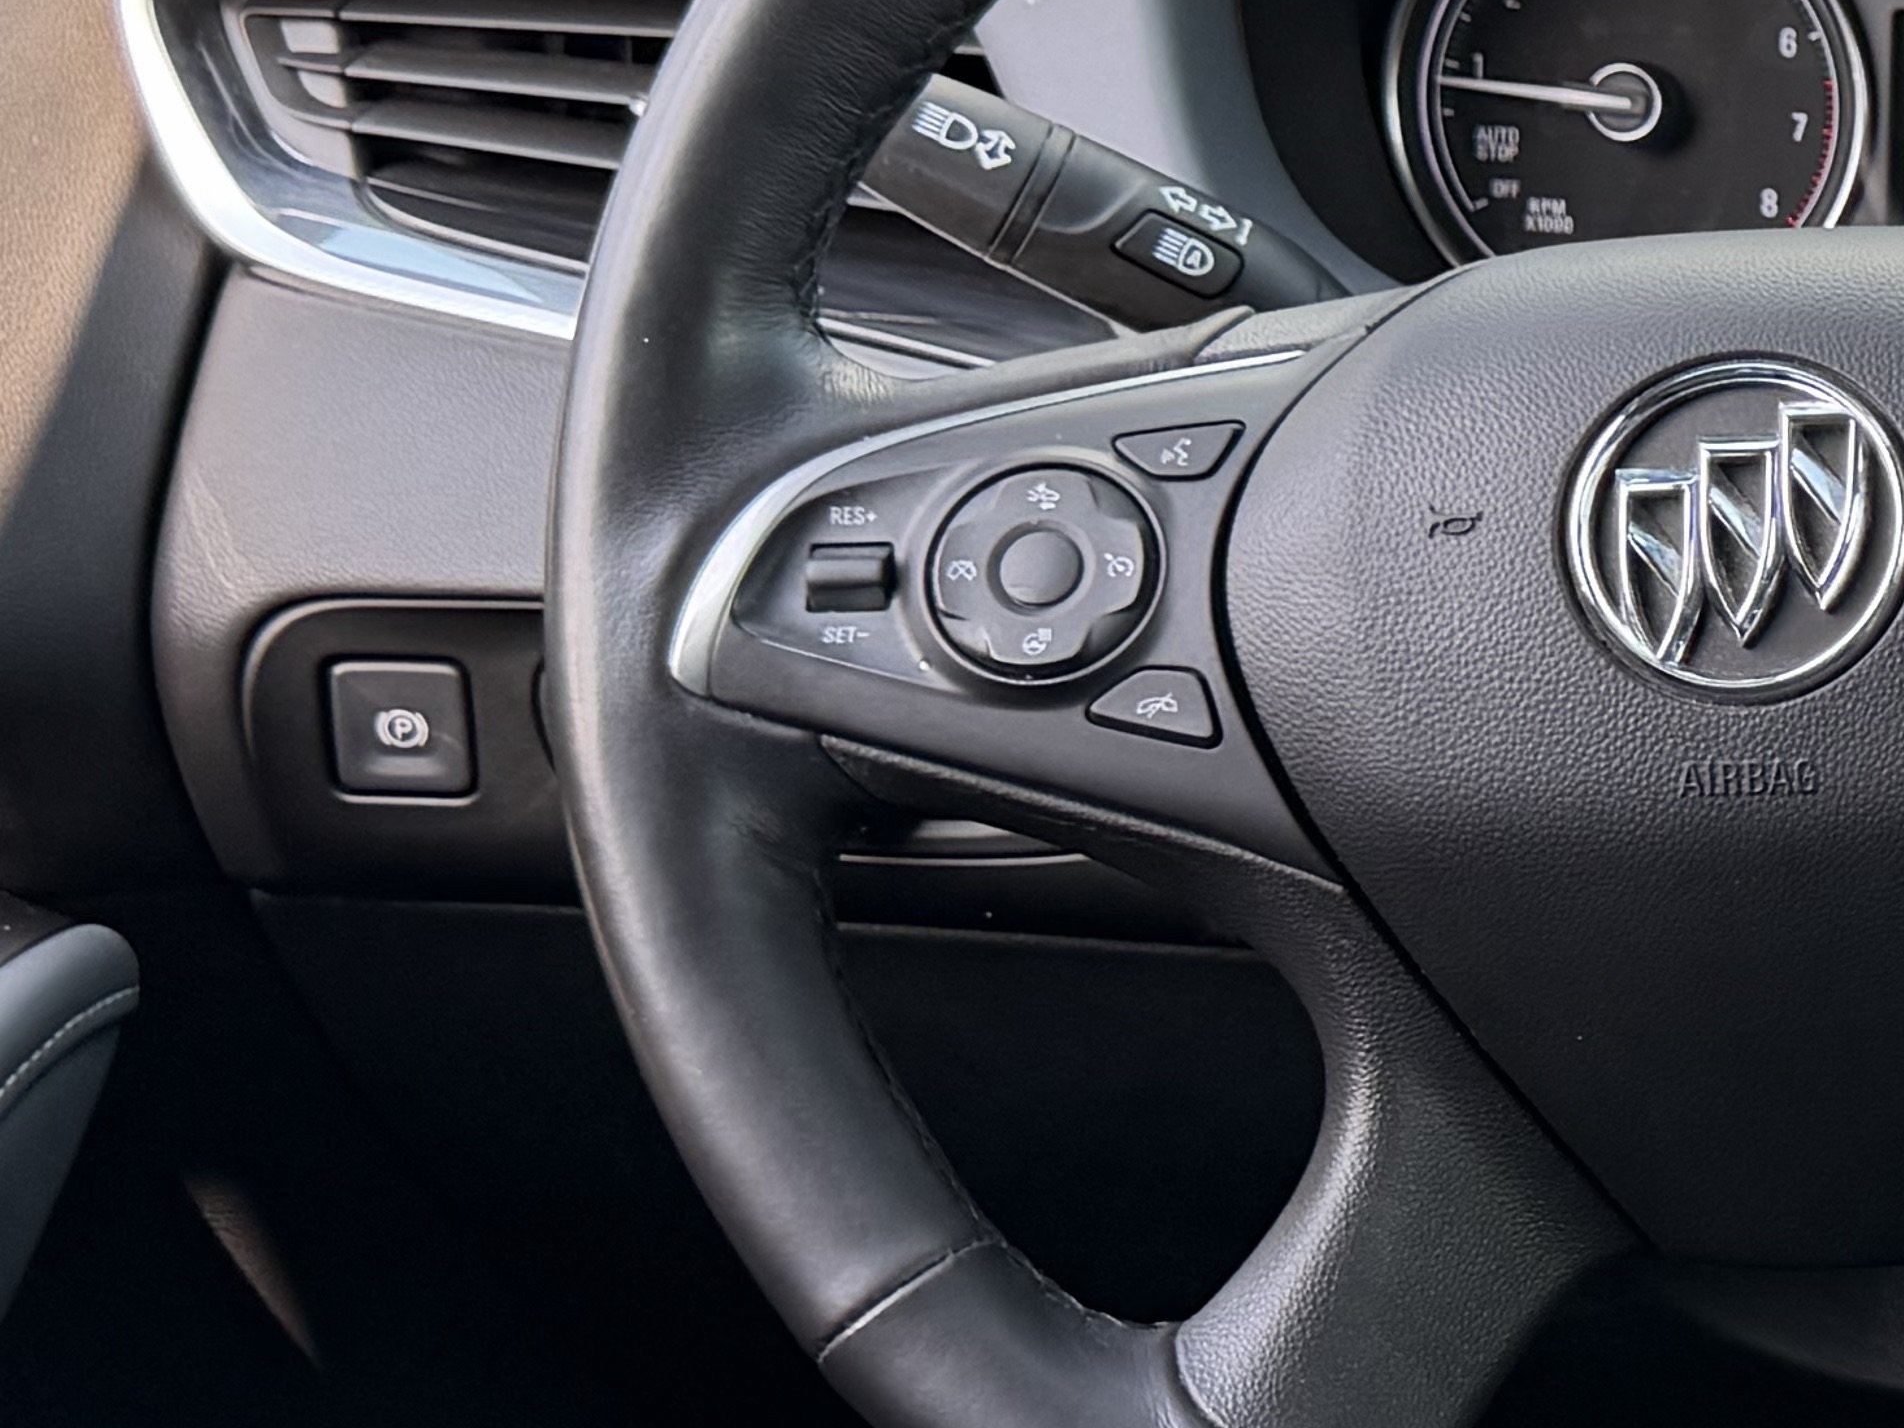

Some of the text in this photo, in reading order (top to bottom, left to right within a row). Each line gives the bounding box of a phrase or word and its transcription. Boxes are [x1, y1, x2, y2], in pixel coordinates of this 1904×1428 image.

[1779, 27, 1798, 59] 6
[1472, 53, 1485, 79] 1
[1791, 112, 1808, 141] 7
[1760, 188, 1778, 219] 8
[1676, 759, 1819, 798] AIRBAG
